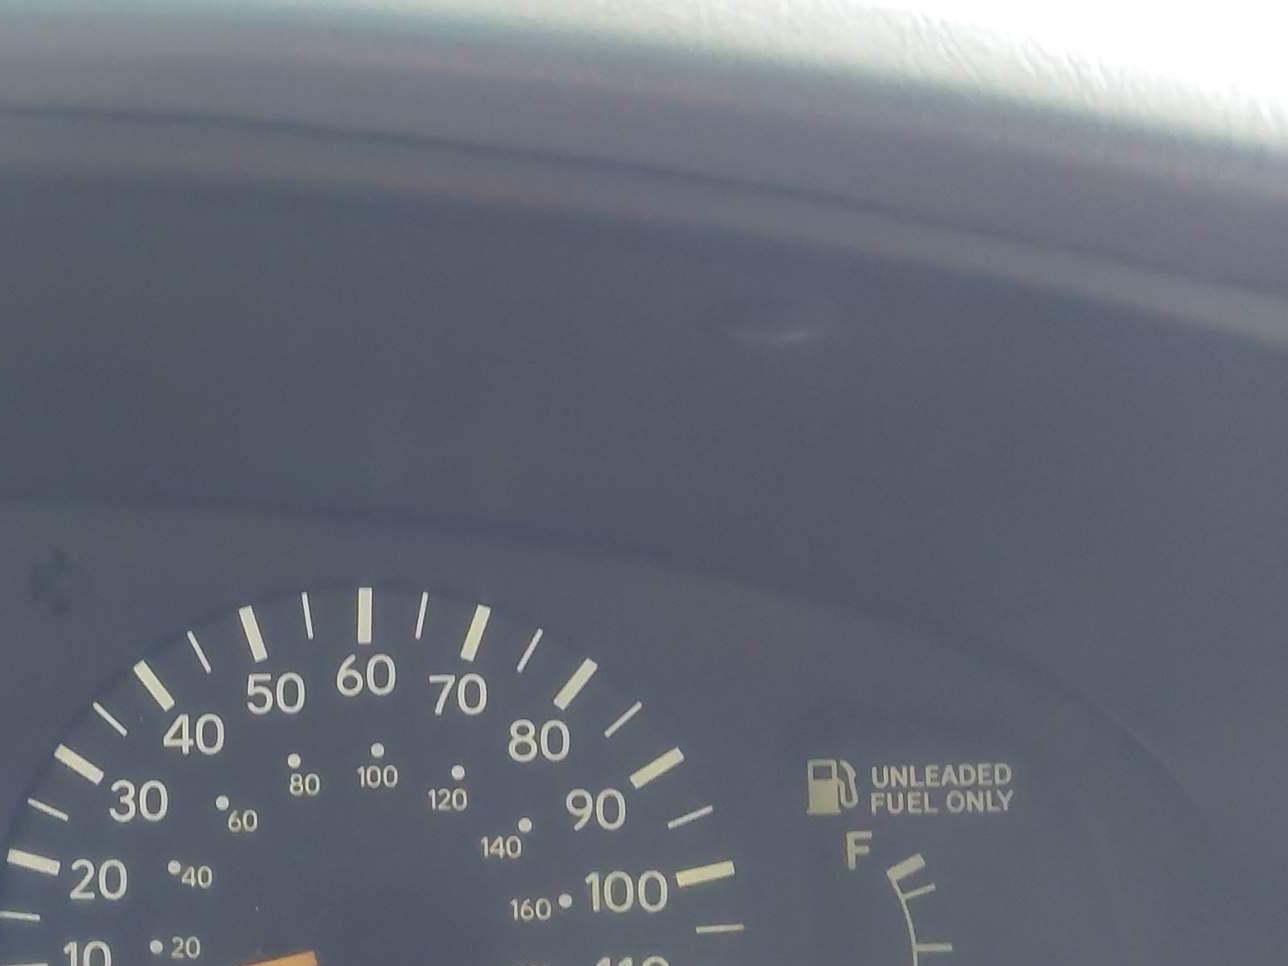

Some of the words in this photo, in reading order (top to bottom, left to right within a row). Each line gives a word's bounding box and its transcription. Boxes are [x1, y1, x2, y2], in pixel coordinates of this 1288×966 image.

[337, 654, 395, 696] 60
[248, 673, 305, 714] 50
[429, 674, 486, 715] 70
[164, 714, 224, 754] 40
[509, 720, 569, 762] 80
[290, 774, 320, 795] 80
[358, 765, 398, 788] 100
[872, 763, 1011, 788] UNLEADED
[110, 780, 168, 822] 30
[429, 789, 467, 810] 120
[566, 789, 625, 831] 90
[871, 792, 937, 814] FUEL
[946, 790, 1013, 812] ONLY
[228, 809, 258, 833] 60
[481, 836, 521, 858] 140
[846, 831, 872, 870] F
[70, 859, 127, 900] 20
[181, 865, 213, 889] 40
[585, 871, 667, 912] 100
[511, 899, 551, 920] 160
[172, 937, 200, 958] 20
